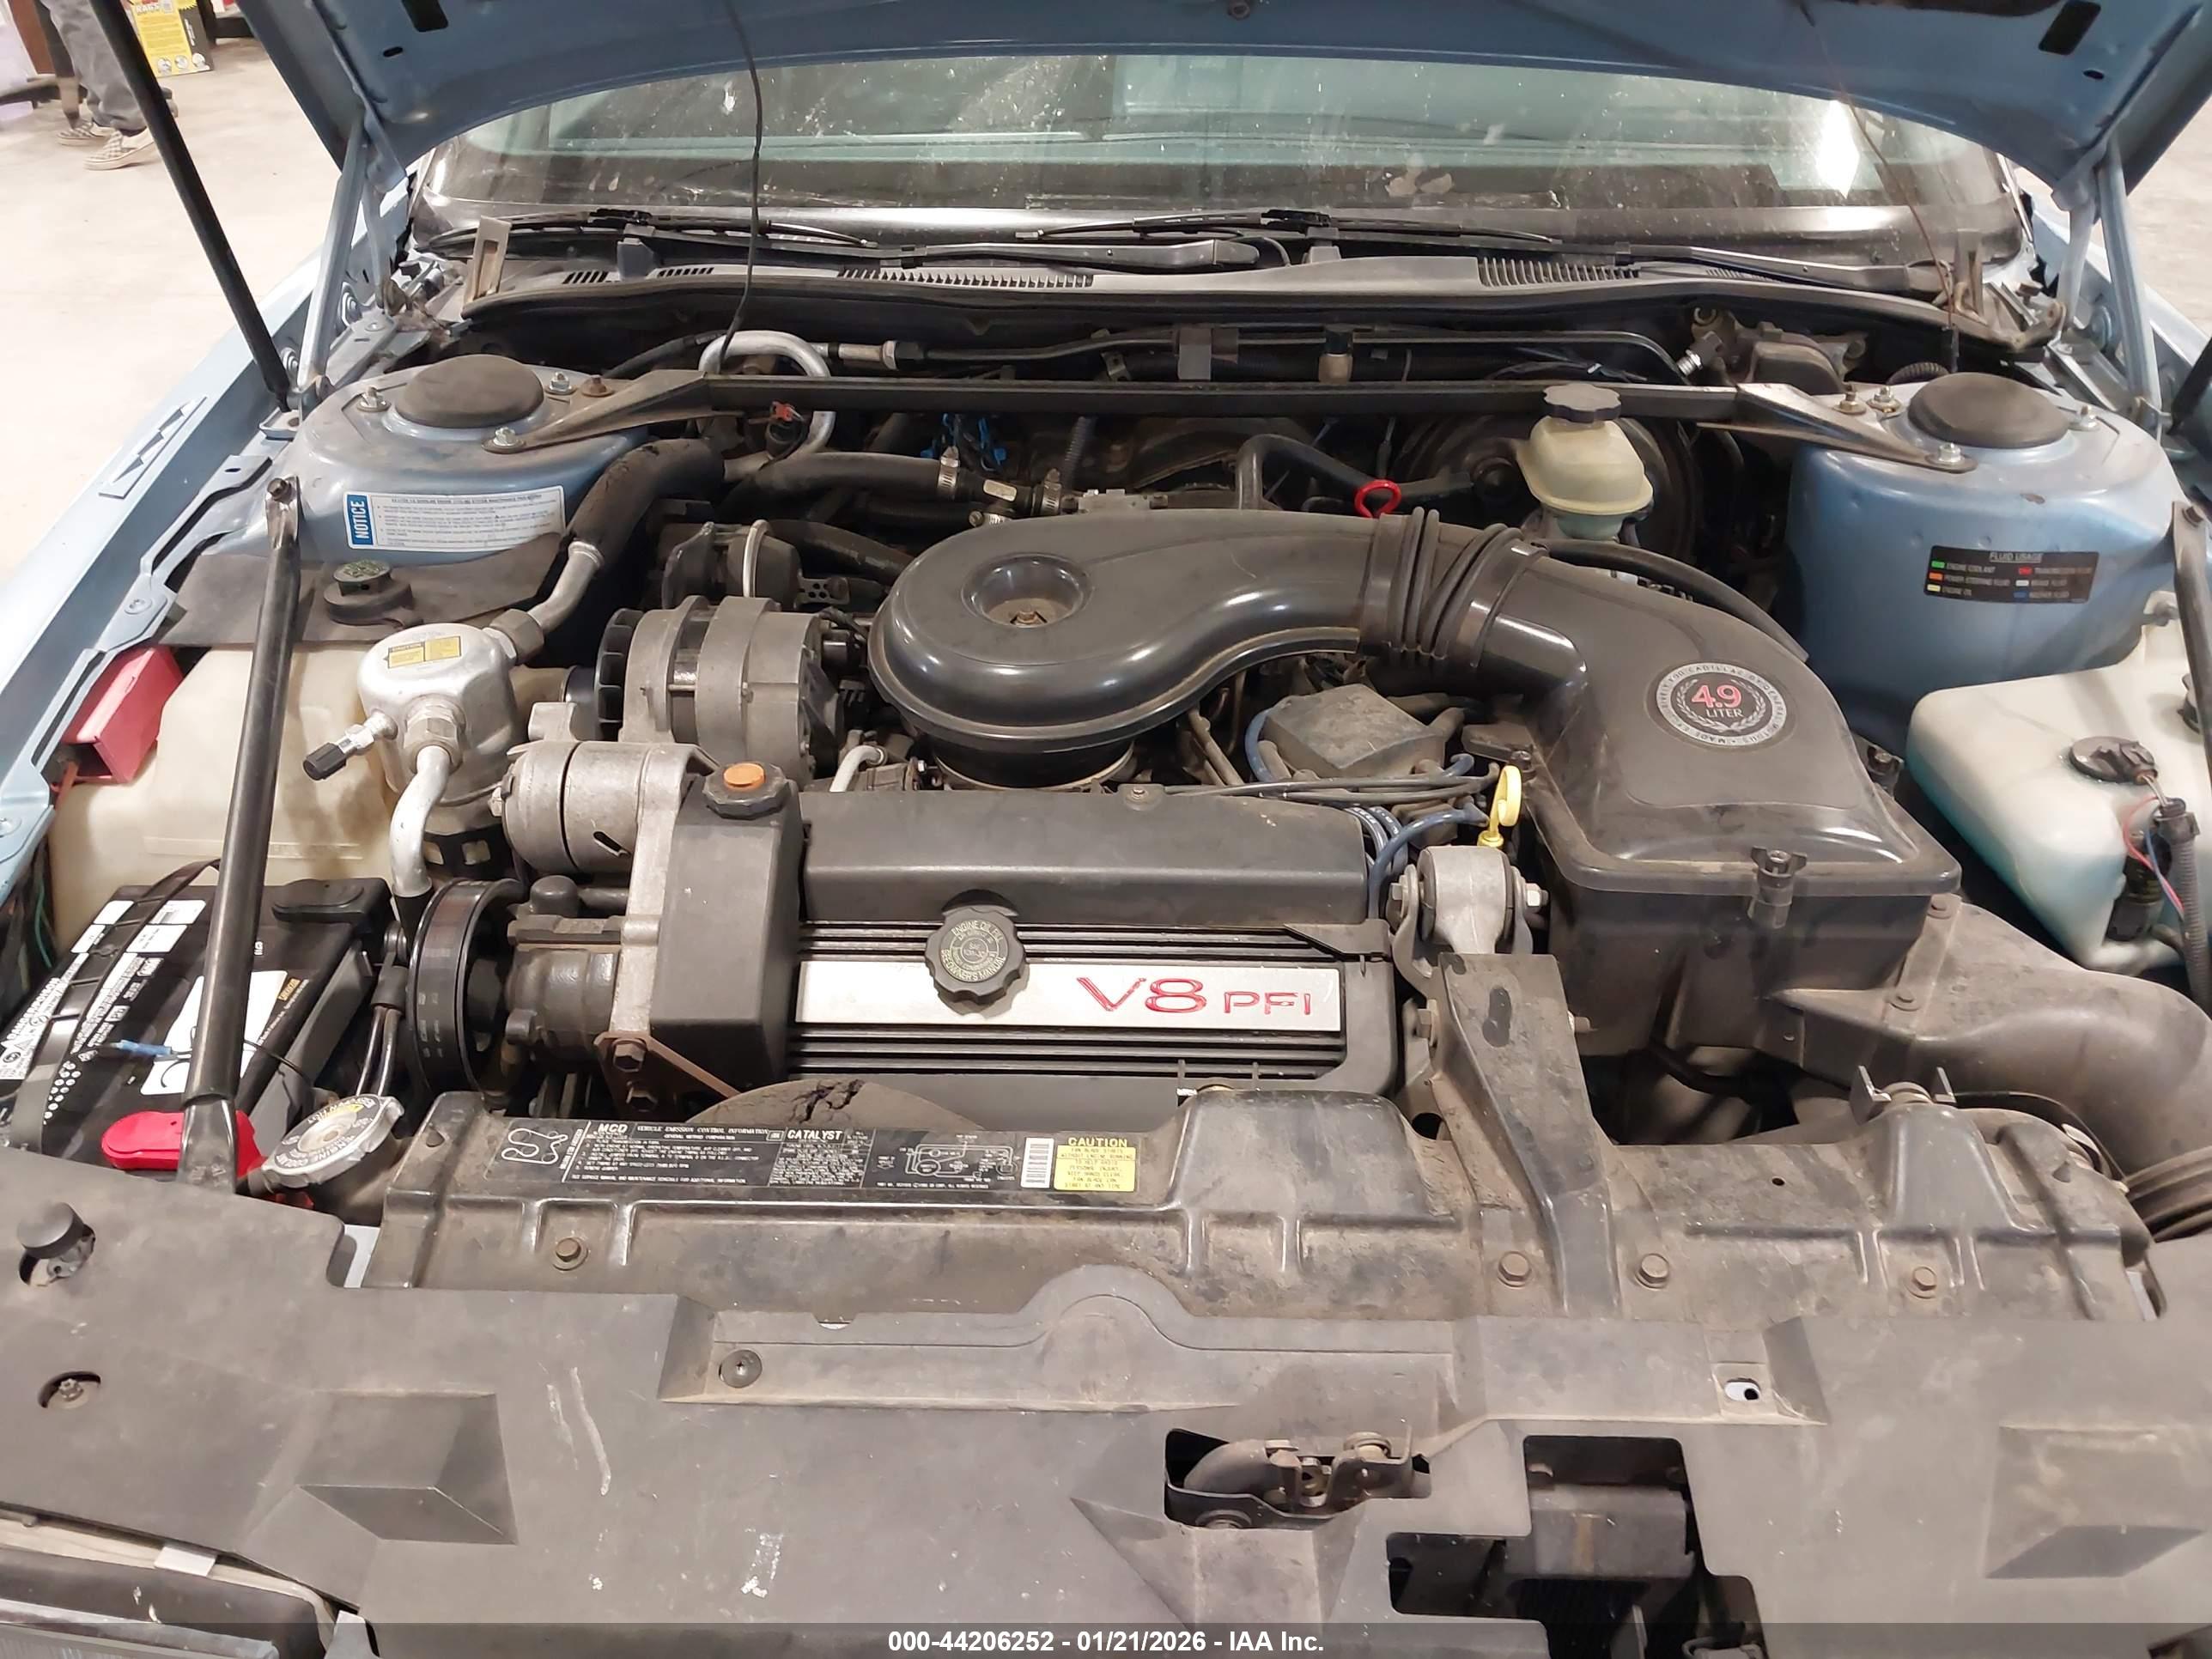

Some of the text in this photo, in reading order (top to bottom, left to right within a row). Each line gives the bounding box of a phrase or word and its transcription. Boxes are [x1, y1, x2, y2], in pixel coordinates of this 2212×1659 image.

[350, 500, 370, 539] NOTICE
[1990, 551, 2044, 562] FLUID USAGE
[1692, 684, 1742, 708] 4.9
[1705, 708, 1744, 718] LITER
[951, 920, 980, 936] ENGINE
[978, 956, 1006, 980] MANUAL
[1076, 977, 1311, 1016] V8 PFI
[598, 1123, 628, 1133] MCD
[787, 1129, 842, 1140] CATALYST
[1067, 1137, 1128, 1148] CAUTION
